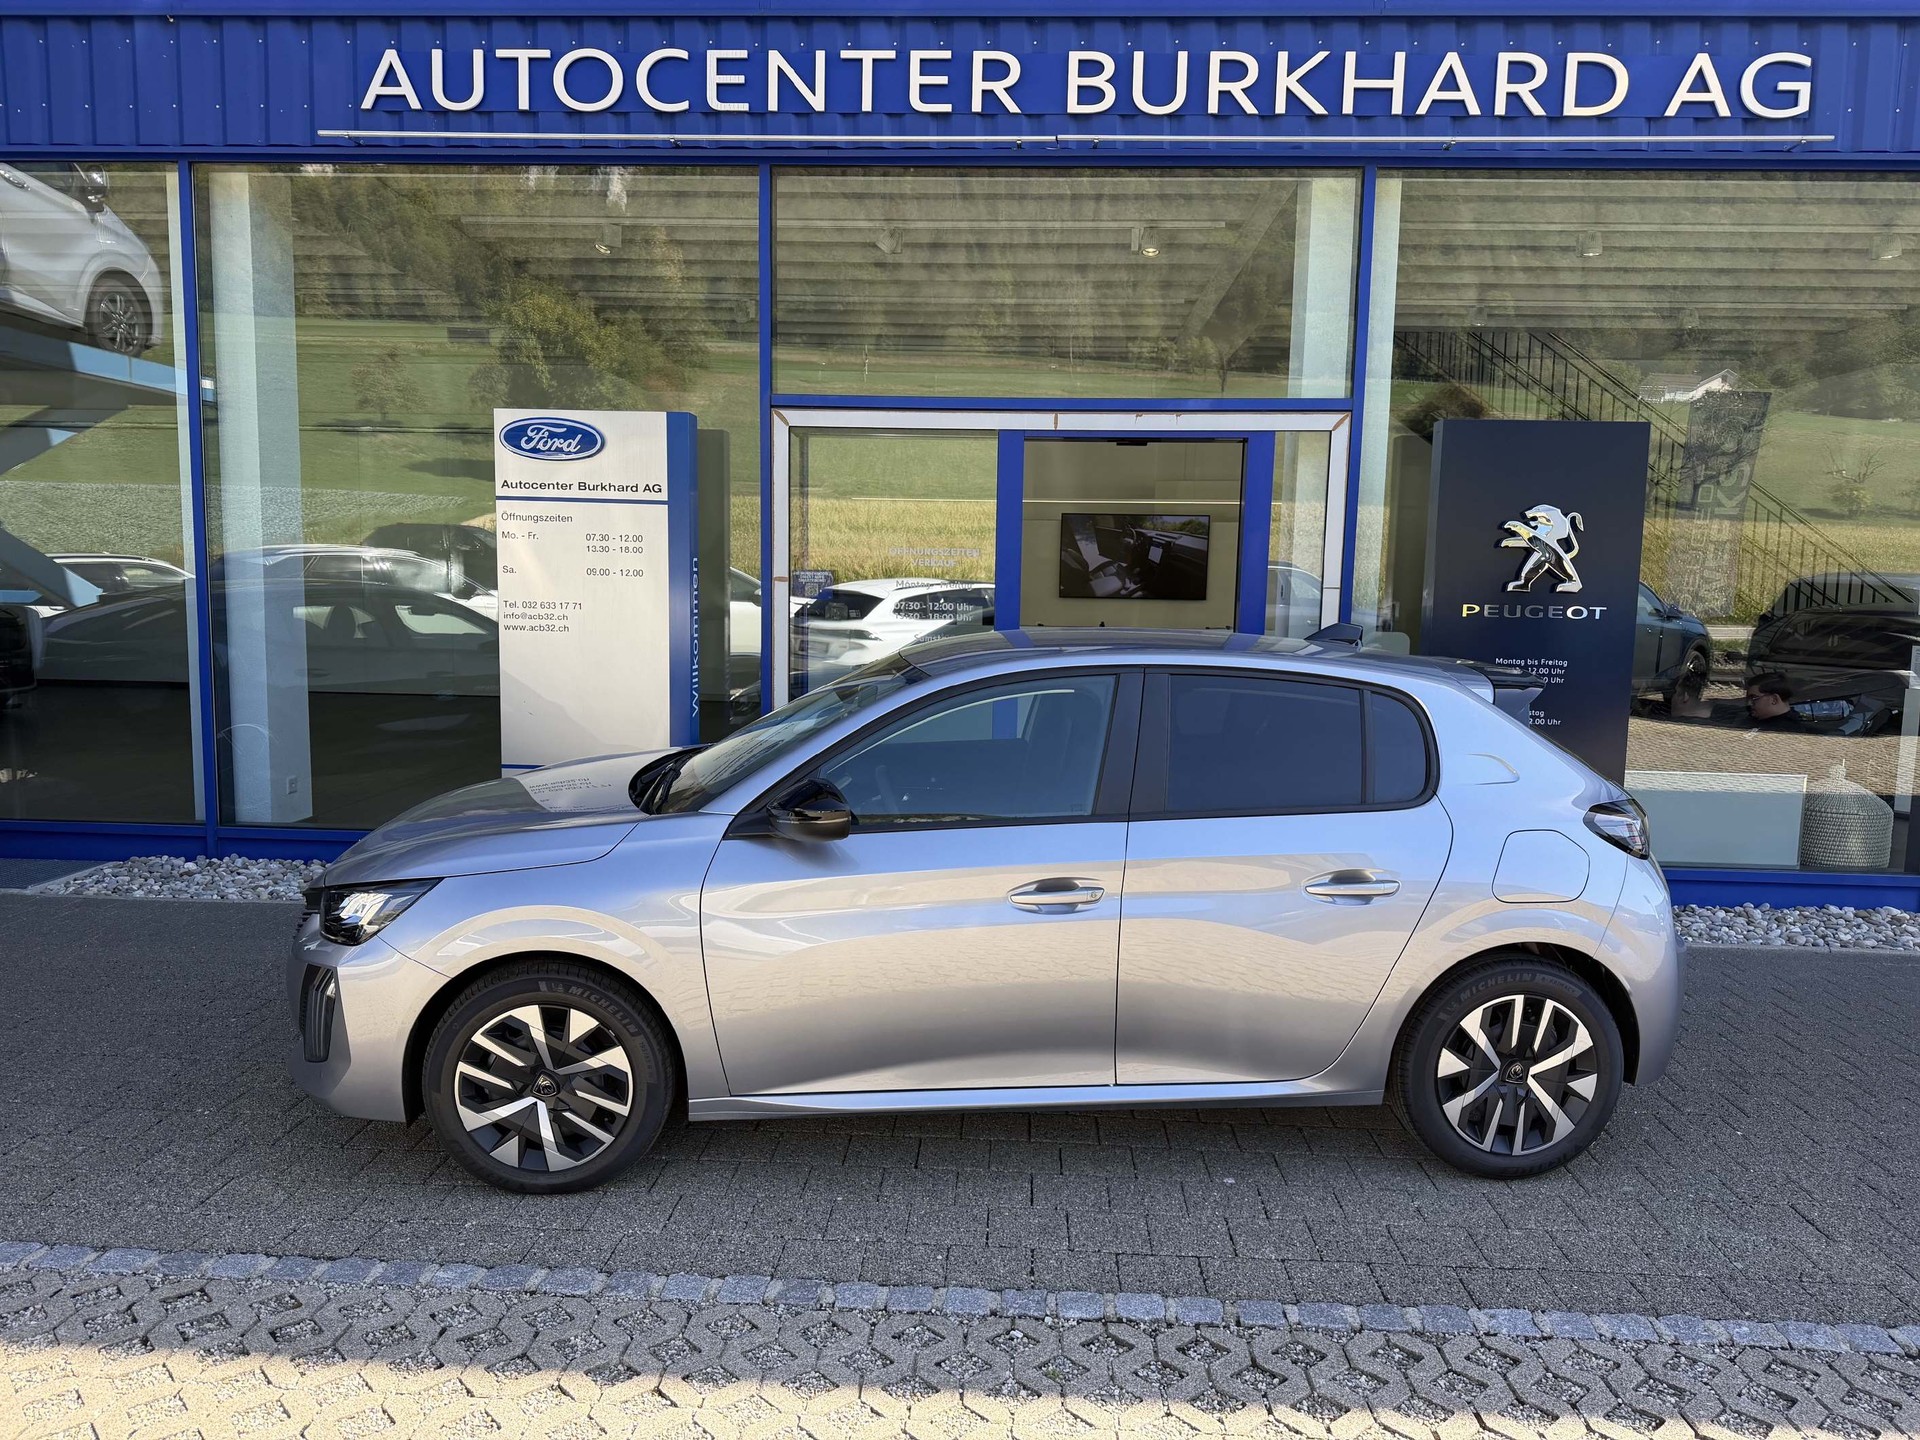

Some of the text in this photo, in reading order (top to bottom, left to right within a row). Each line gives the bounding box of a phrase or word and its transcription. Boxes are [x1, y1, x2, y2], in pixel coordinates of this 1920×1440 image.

[360, 47, 1812, 119] AUTOCENTER BURKHARD AG
[520, 424, 581, 453] Ford
[500, 479, 662, 493] Autocenter Burkhard AG
[501, 511, 573, 523] Öffnungszeiten
[501, 531, 519, 540] Mo.
[527, 531, 539, 540] Fr.
[585, 533, 610, 542] 07.30
[619, 534, 644, 543] 12.00
[586, 545, 610, 553] 13.30
[619, 546, 644, 554] 18.00
[502, 564, 517, 574] Sa.
[586, 567, 611, 577] 09.00
[619, 568, 644, 578] 12.00
[503, 600, 582, 610] Tel. 032 633 17 71
[894, 602, 920, 610] 07:30
[929, 602, 954, 611] 12:00
[956, 603, 974, 611] Uhr
[503, 612, 569, 621] info@acb32.ch
[1461, 603, 1607, 620] PEUGEOT
[956, 613, 974, 622] Uhr
[503, 623, 570, 633] www.acb32.ch
[692, 557, 700, 717] Willkommen
[1495, 657, 1568, 668] Montag bis Freitag
[1551, 667, 1566, 675] Uhr
[1550, 676, 1565, 684] Uhr
[1547, 718, 1562, 726] Uhr
[1459, 973, 1532, 1002] MICHELIN
[568, 986, 640, 1035] MICHELIN
